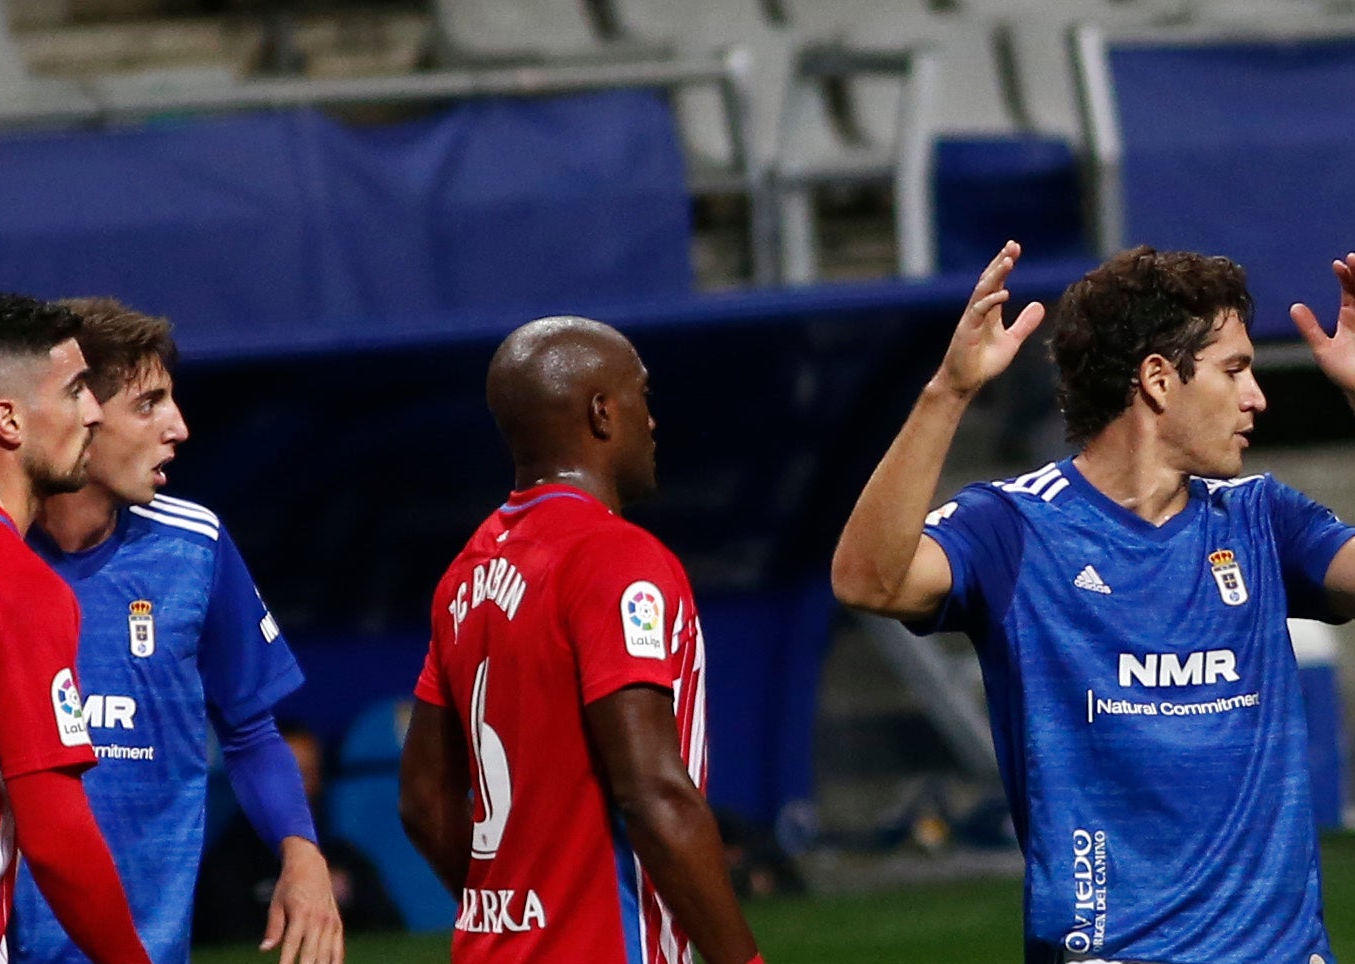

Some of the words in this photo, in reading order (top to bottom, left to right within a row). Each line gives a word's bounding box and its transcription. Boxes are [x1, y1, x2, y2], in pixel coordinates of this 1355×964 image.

[1118, 649, 1241, 688] NMR
[1096, 698, 1158, 716] Natural
[1094, 830, 1107, 885] CAMINO
[1065, 829, 1095, 954] OVIEDO
[1095, 886, 1107, 910] DEL
